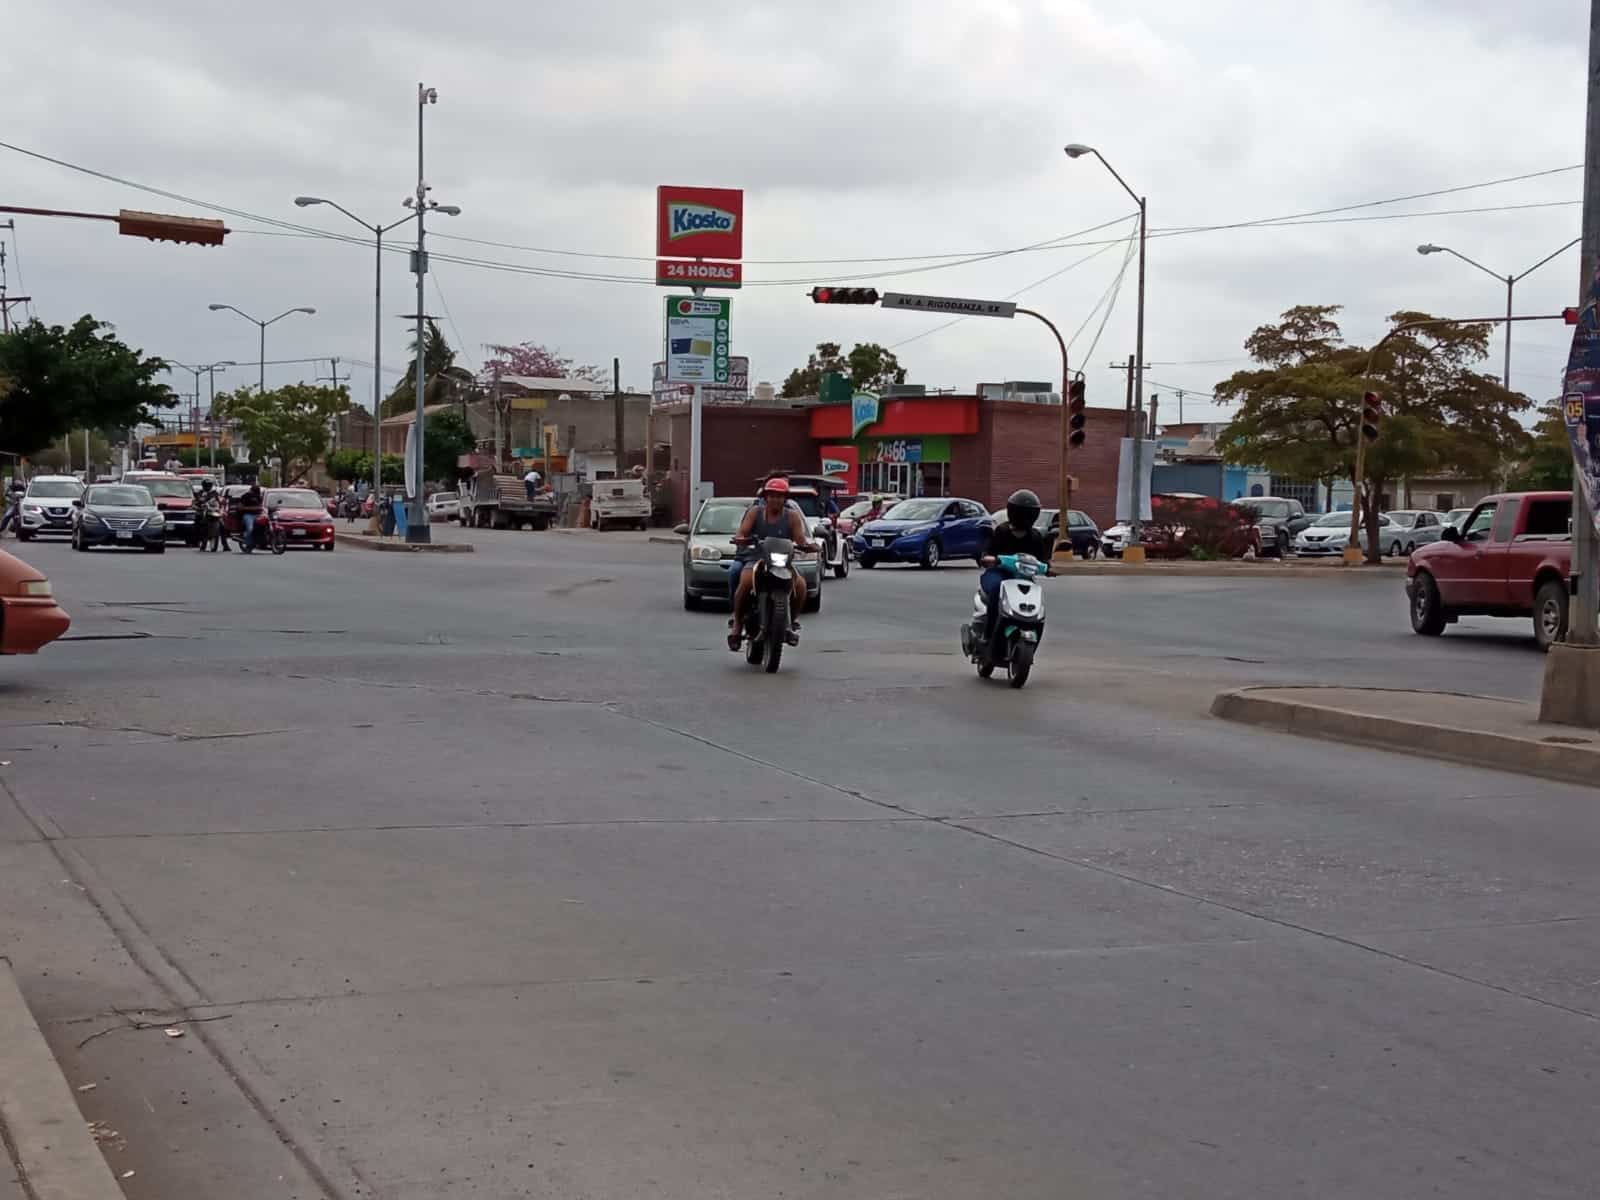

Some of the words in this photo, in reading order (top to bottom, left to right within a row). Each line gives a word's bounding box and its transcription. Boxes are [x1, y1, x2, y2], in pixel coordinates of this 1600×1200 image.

[674, 208, 730, 233] Kiosko
[667, 265, 685, 276] 24
[687, 266, 734, 278] HORAS
[1567, 402, 1583, 417] 05
